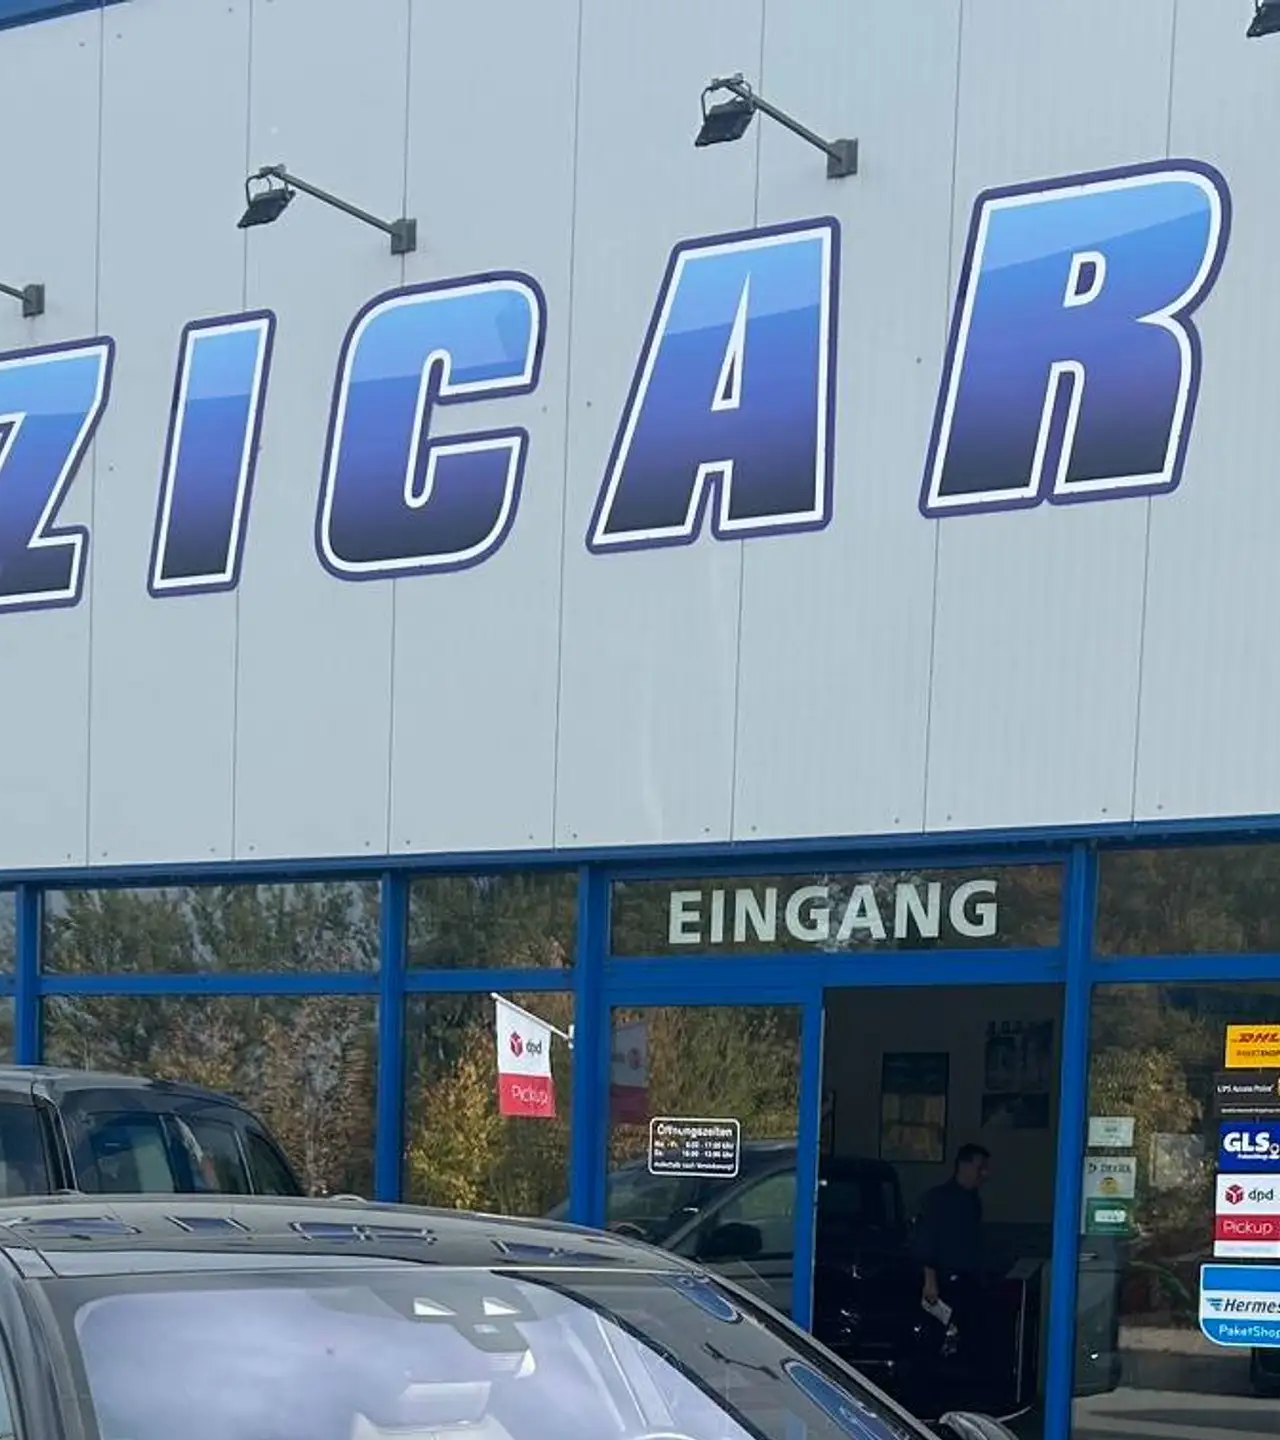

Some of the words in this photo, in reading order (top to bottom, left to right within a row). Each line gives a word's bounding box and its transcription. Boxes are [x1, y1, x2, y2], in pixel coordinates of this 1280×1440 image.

[667, 880, 999, 945] EINGANG
[1239, 1032, 1280, 1043] DHL
[526, 1039, 542, 1056] dpd
[1223, 1132, 1271, 1152] GLS
[1248, 1189, 1274, 1203] dpd
[1223, 1220, 1274, 1237] Pickup
